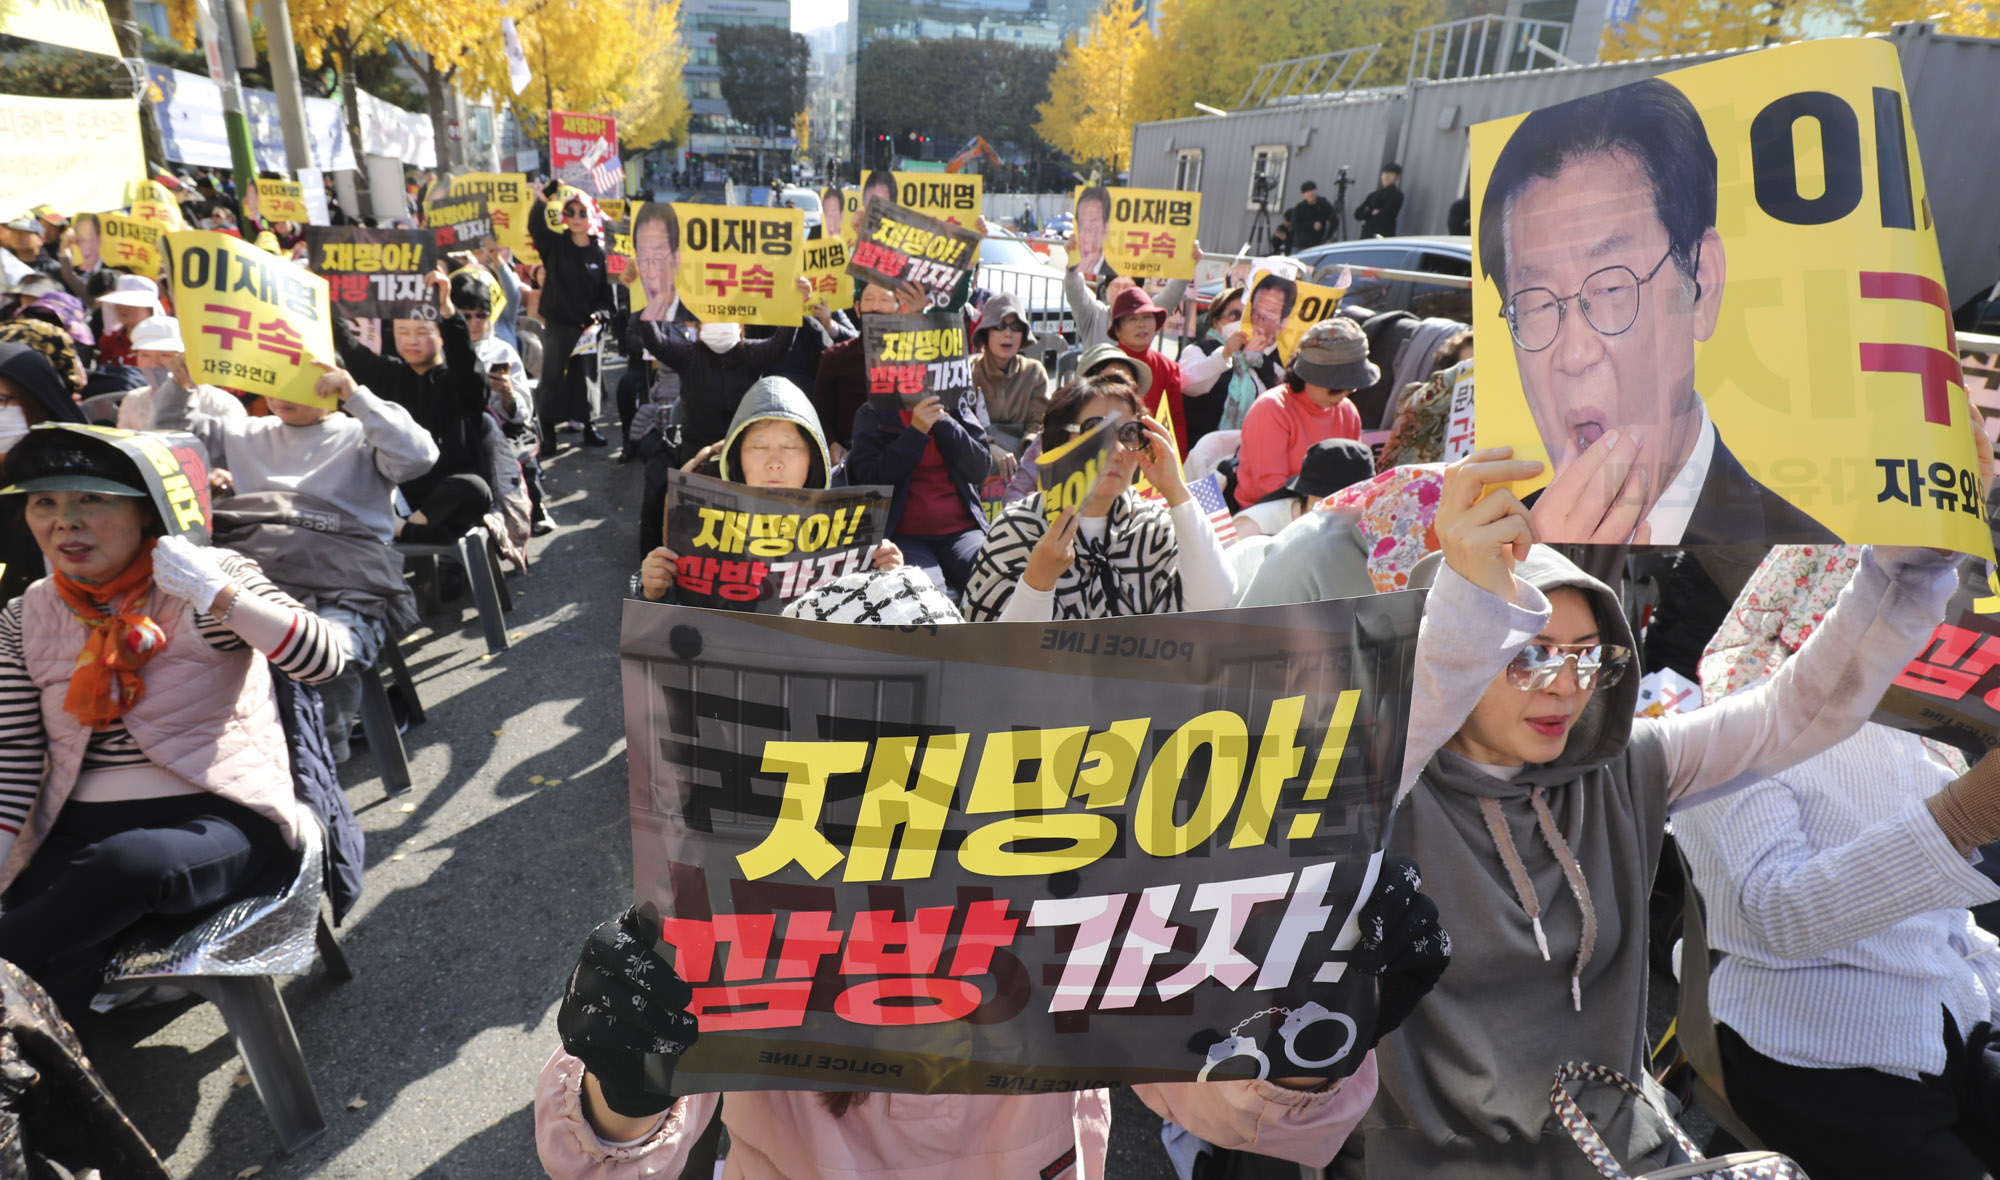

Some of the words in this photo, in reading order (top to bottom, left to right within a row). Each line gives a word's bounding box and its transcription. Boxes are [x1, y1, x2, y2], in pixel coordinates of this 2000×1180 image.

[1750, 86, 1932, 231] 이
[903, 183, 975, 209] 이재명
[1115, 198, 1193, 226] 이재명
[687, 217, 793, 256] 이재명
[872, 217, 967, 265] 재명아!
[1125, 231, 1177, 259] 구속
[320, 242, 423, 272] 재명아!
[181, 246, 319, 322] 이재명
[705, 263, 775, 299] 구속
[201, 303, 303, 367] 구속
[880, 327, 963, 361] 재명아!
[202, 359, 277, 386] 자유와연대
[869, 363, 927, 394] 깜방
[927, 359, 973, 391] 가자!
[692, 505, 866, 557] 재명아!
[672, 555, 769, 602] 깜방
[735, 689, 1362, 882] 재명아!
[663, 898, 1020, 1032] 깜방
[1025, 848, 1385, 1014] 가자!
